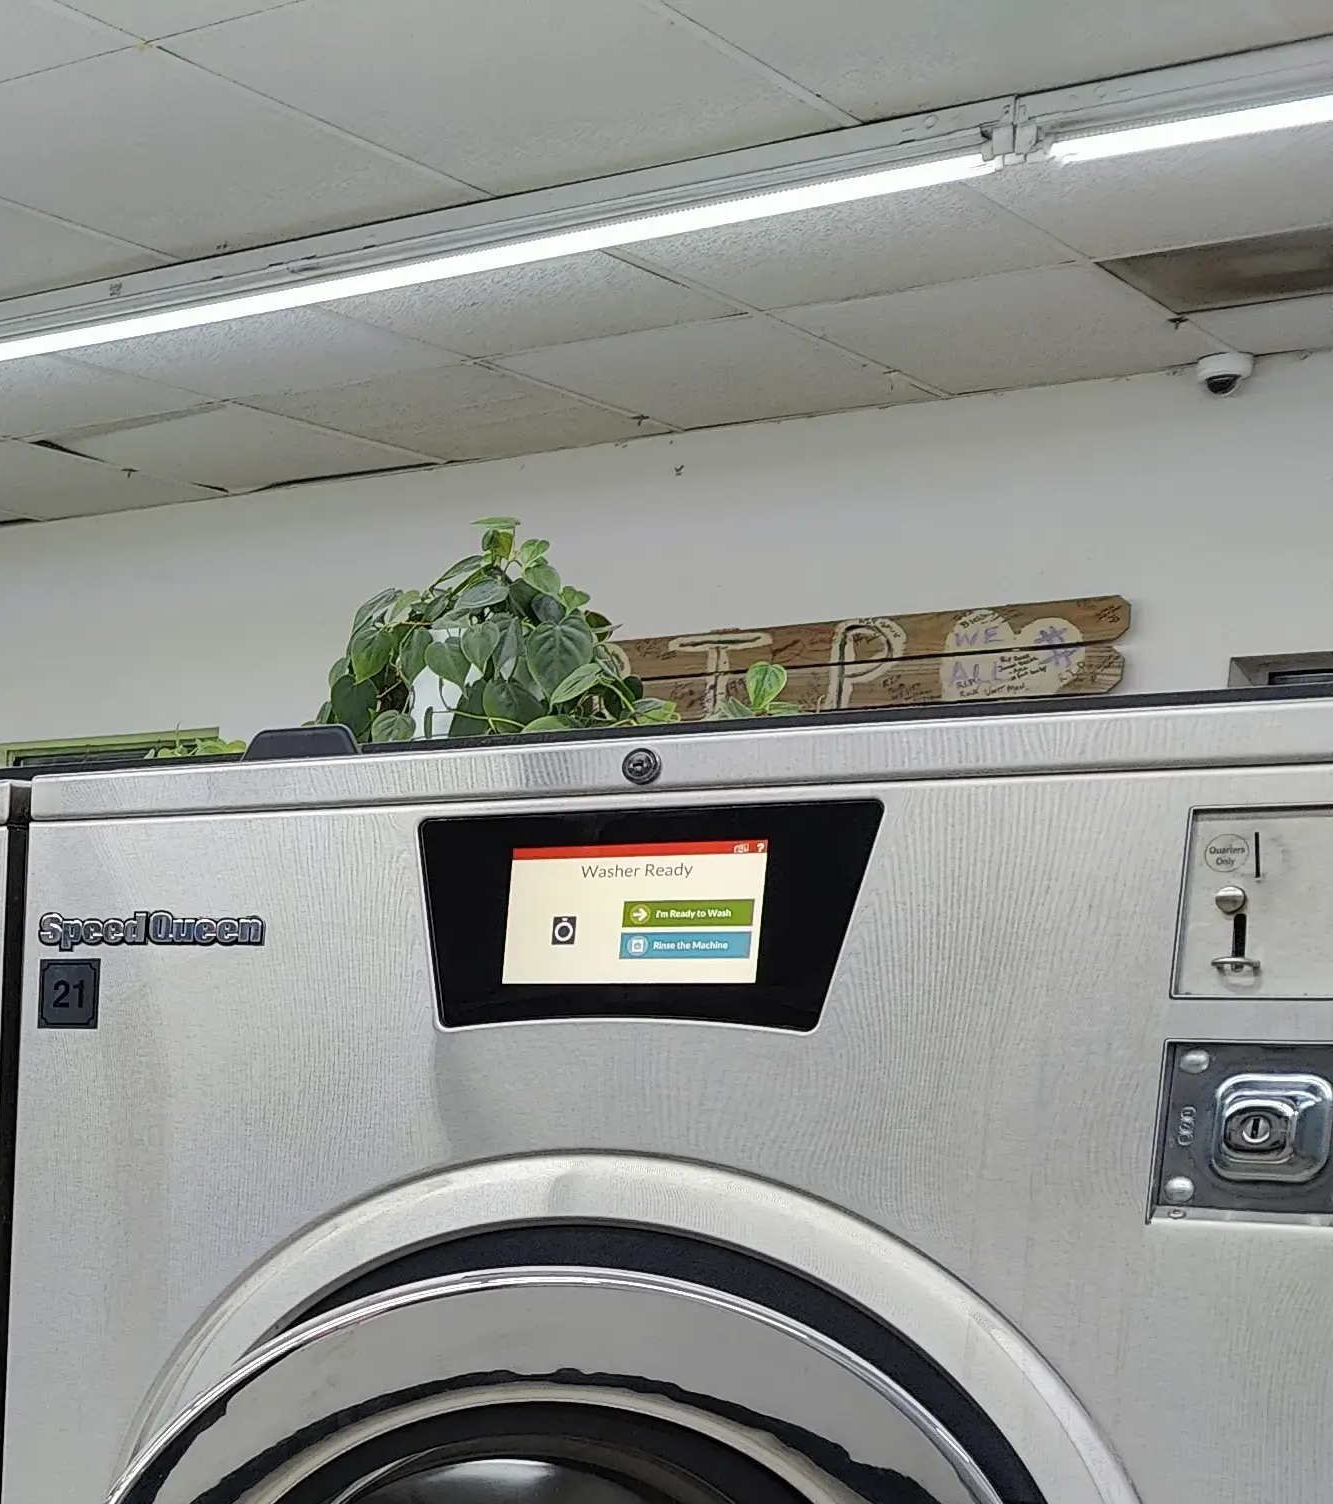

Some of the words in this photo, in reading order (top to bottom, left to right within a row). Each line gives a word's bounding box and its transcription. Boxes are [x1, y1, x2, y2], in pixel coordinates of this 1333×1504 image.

[1209, 845, 1245, 855] Quarters
[1216, 857, 1235, 867] Only
[581, 864, 640, 878] Washer
[644, 863, 694, 878] Ready
[655, 909, 668, 919] I'm
[669, 909, 695, 920] Ready
[696, 909, 706, 918] to
[707, 908, 732, 918] Wash
[38, 911, 149, 952] Speed
[148, 910, 267, 947] Queen
[653, 940, 675, 950] Rinse
[676, 940, 691, 950] the
[692, 940, 729, 950] Machine
[52, 979, 85, 1009] 21
